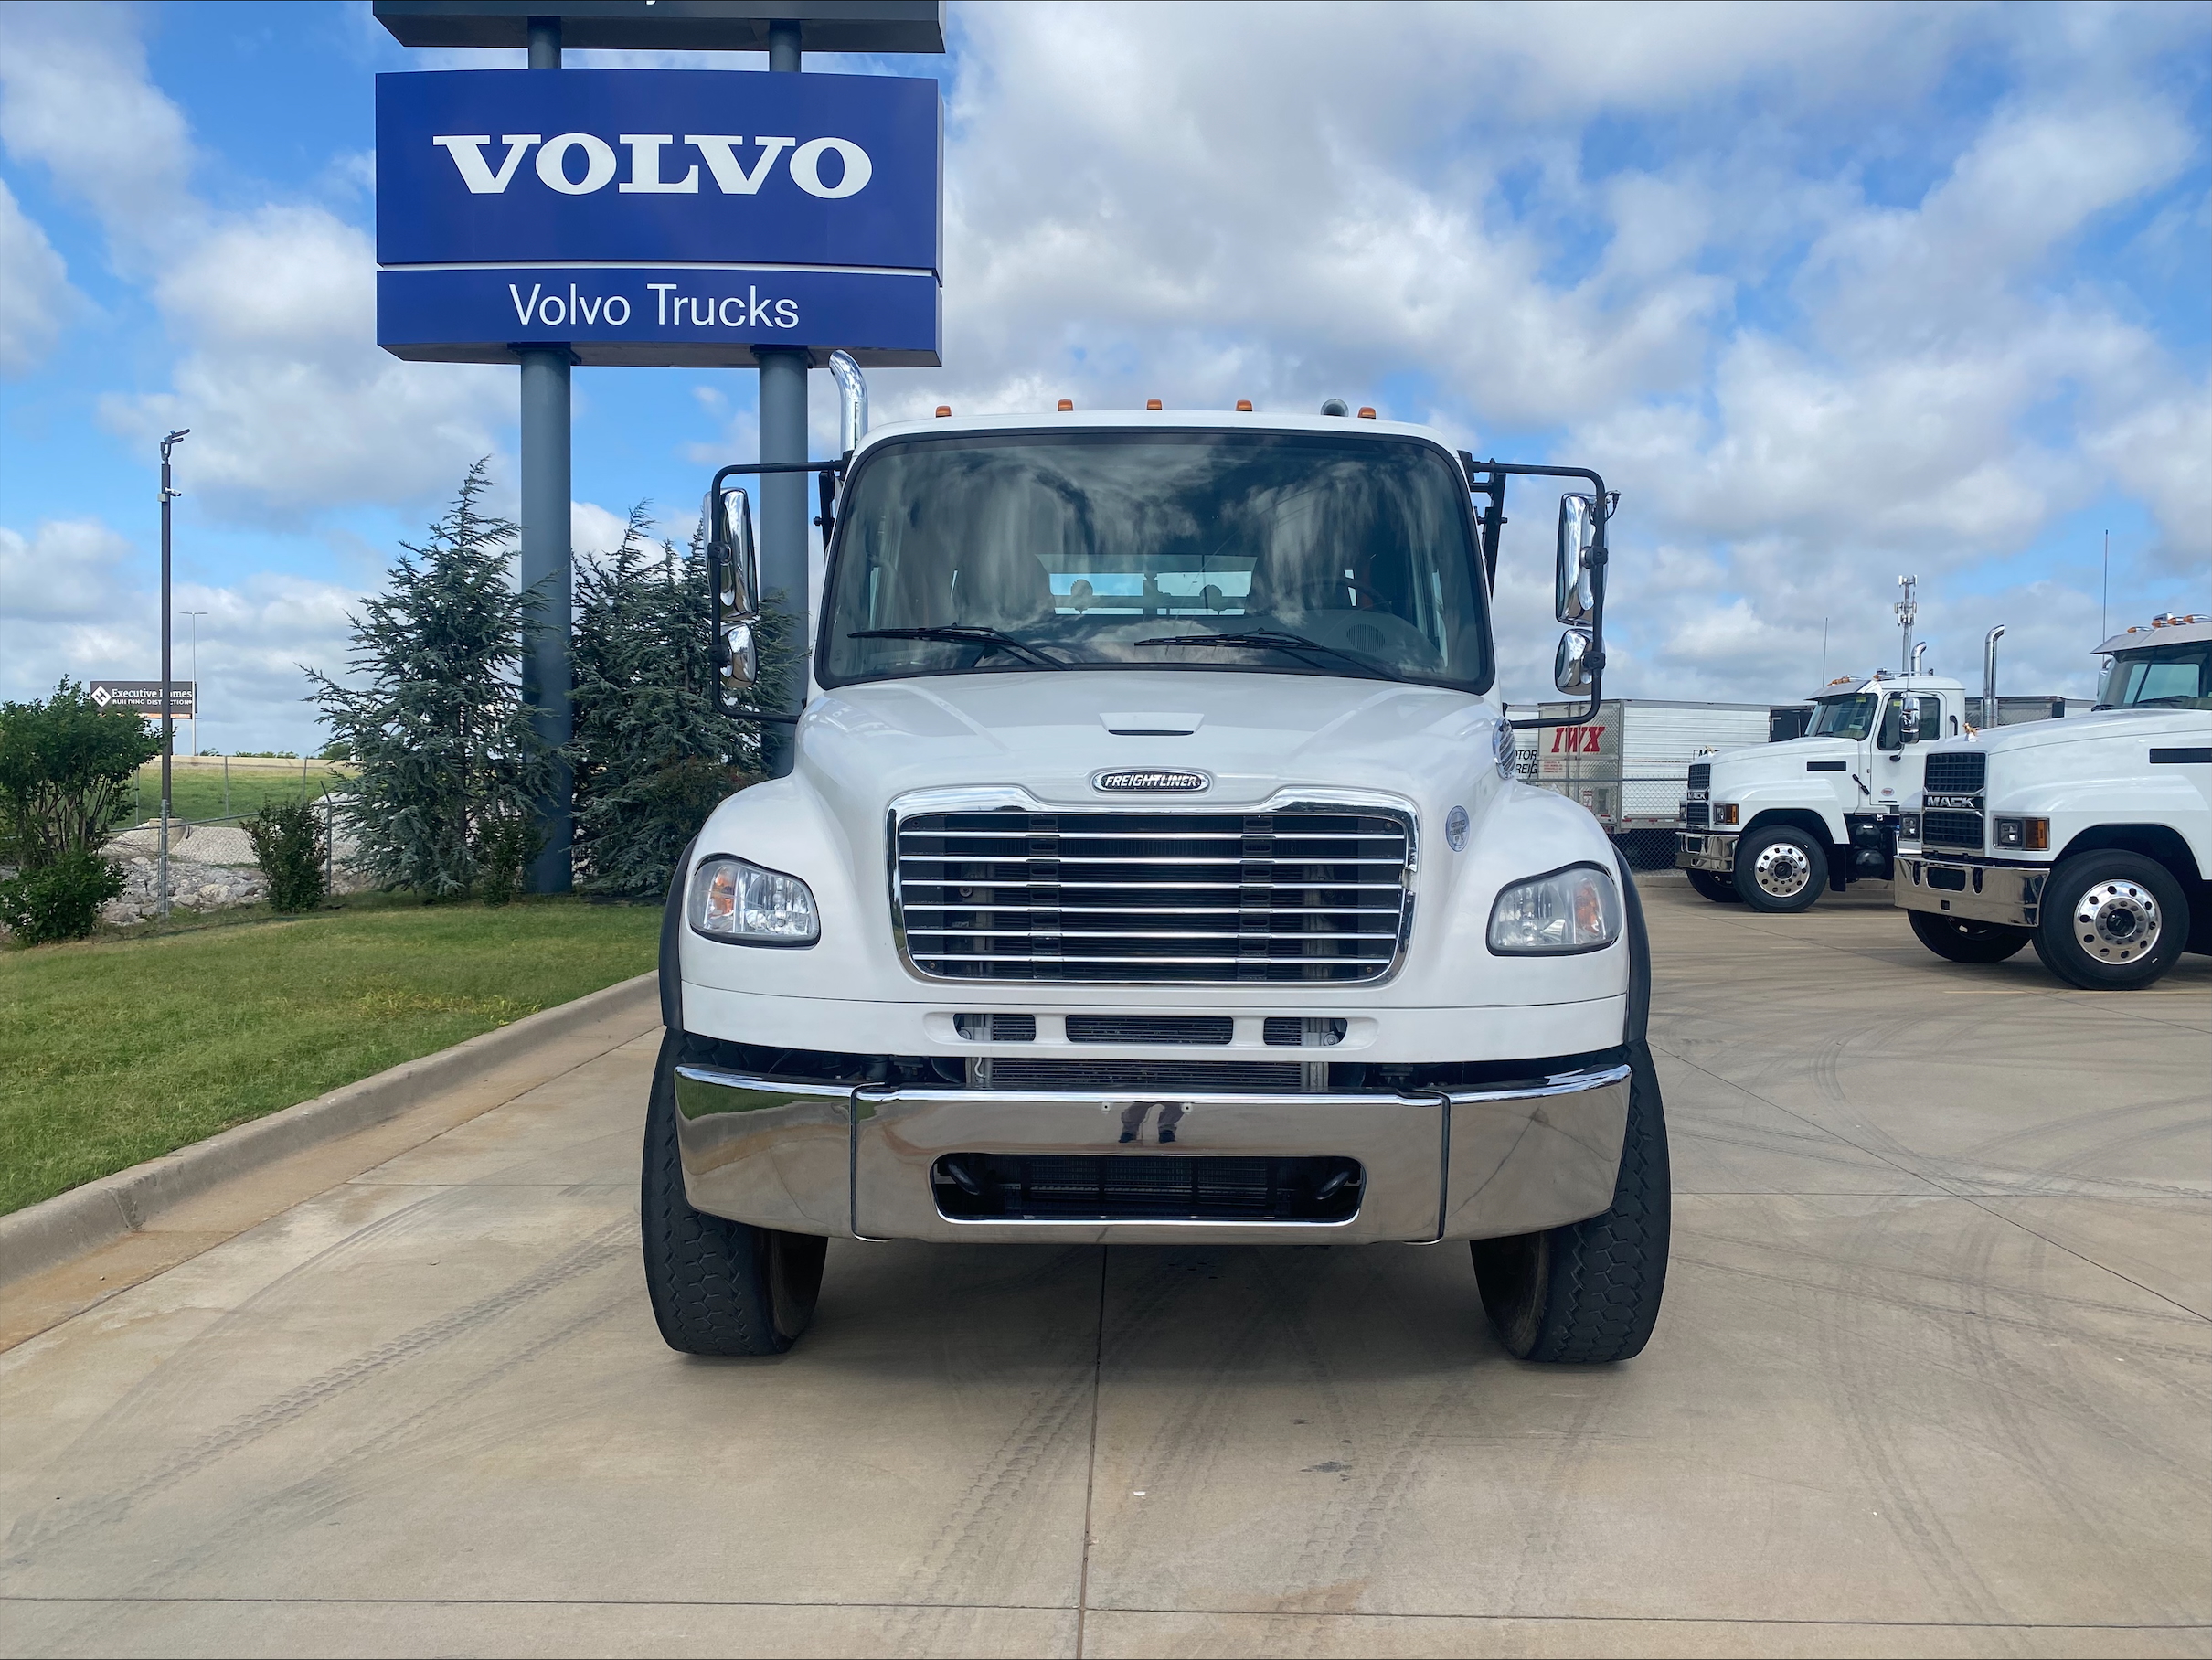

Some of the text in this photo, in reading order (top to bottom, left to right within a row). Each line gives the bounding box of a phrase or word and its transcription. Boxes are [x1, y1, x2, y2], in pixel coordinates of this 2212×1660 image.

[432, 133, 873, 199] VOLVO
[508, 284, 800, 329] Volvo Trucks
[112, 687, 192, 698] Executive mes
[1551, 727, 1605, 752] IWX
[1515, 750, 1538, 761] TOR
[1105, 774, 1196, 787] FREIGHTLINER
[1927, 796, 1975, 809] MACK
